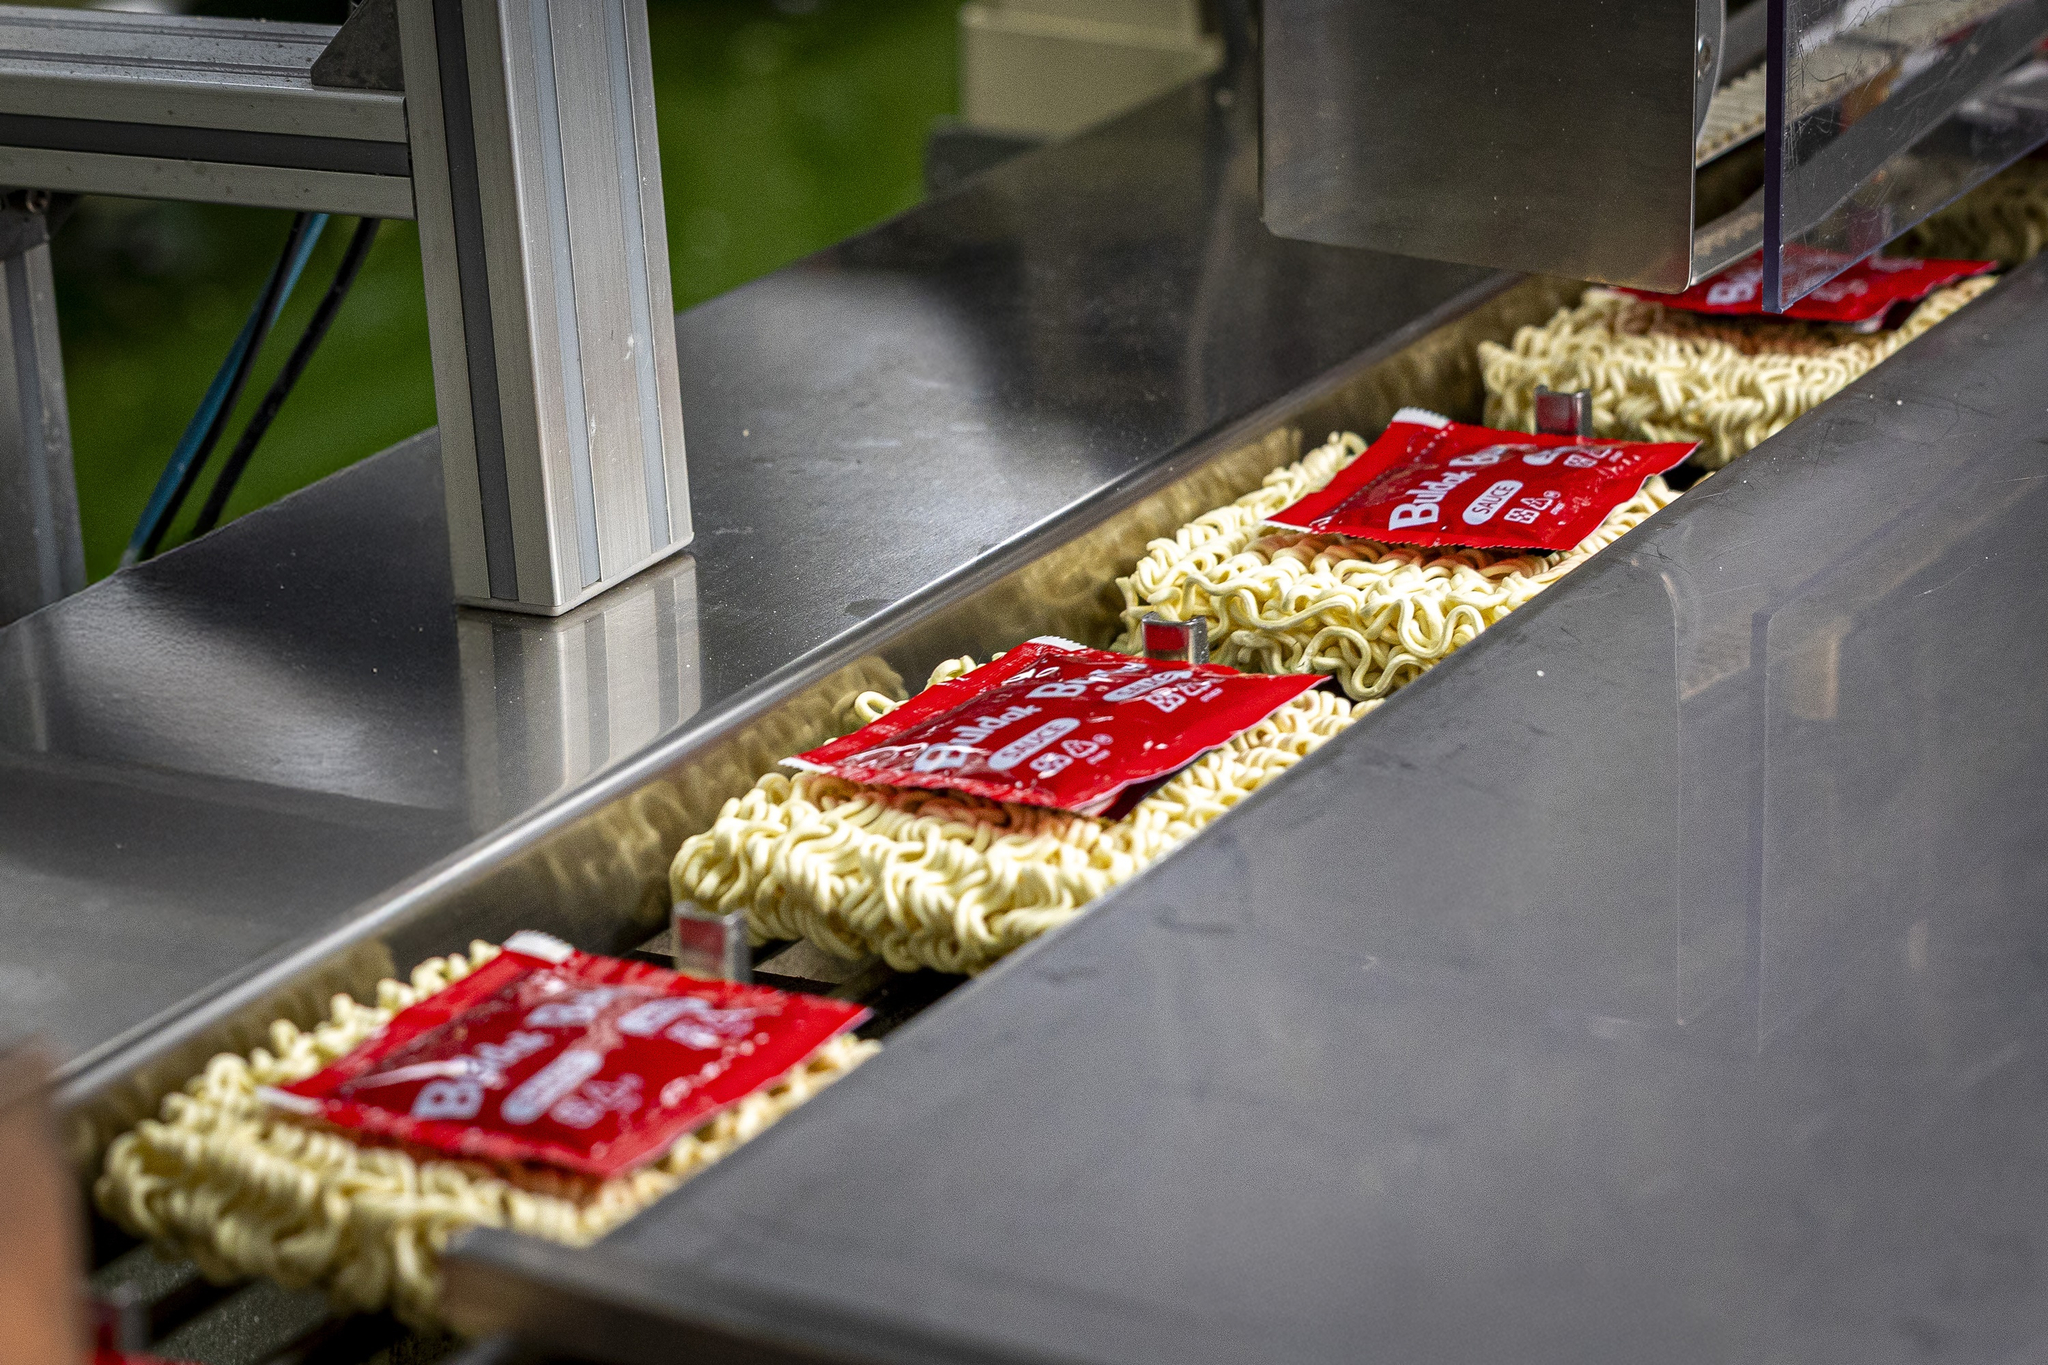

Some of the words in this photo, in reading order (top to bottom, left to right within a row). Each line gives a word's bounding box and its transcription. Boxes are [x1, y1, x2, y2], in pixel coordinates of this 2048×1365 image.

[1388, 470, 1477, 531] Buldak
[1470, 484, 1514, 516] SAUCE
[912, 704, 1043, 773] Buldak
